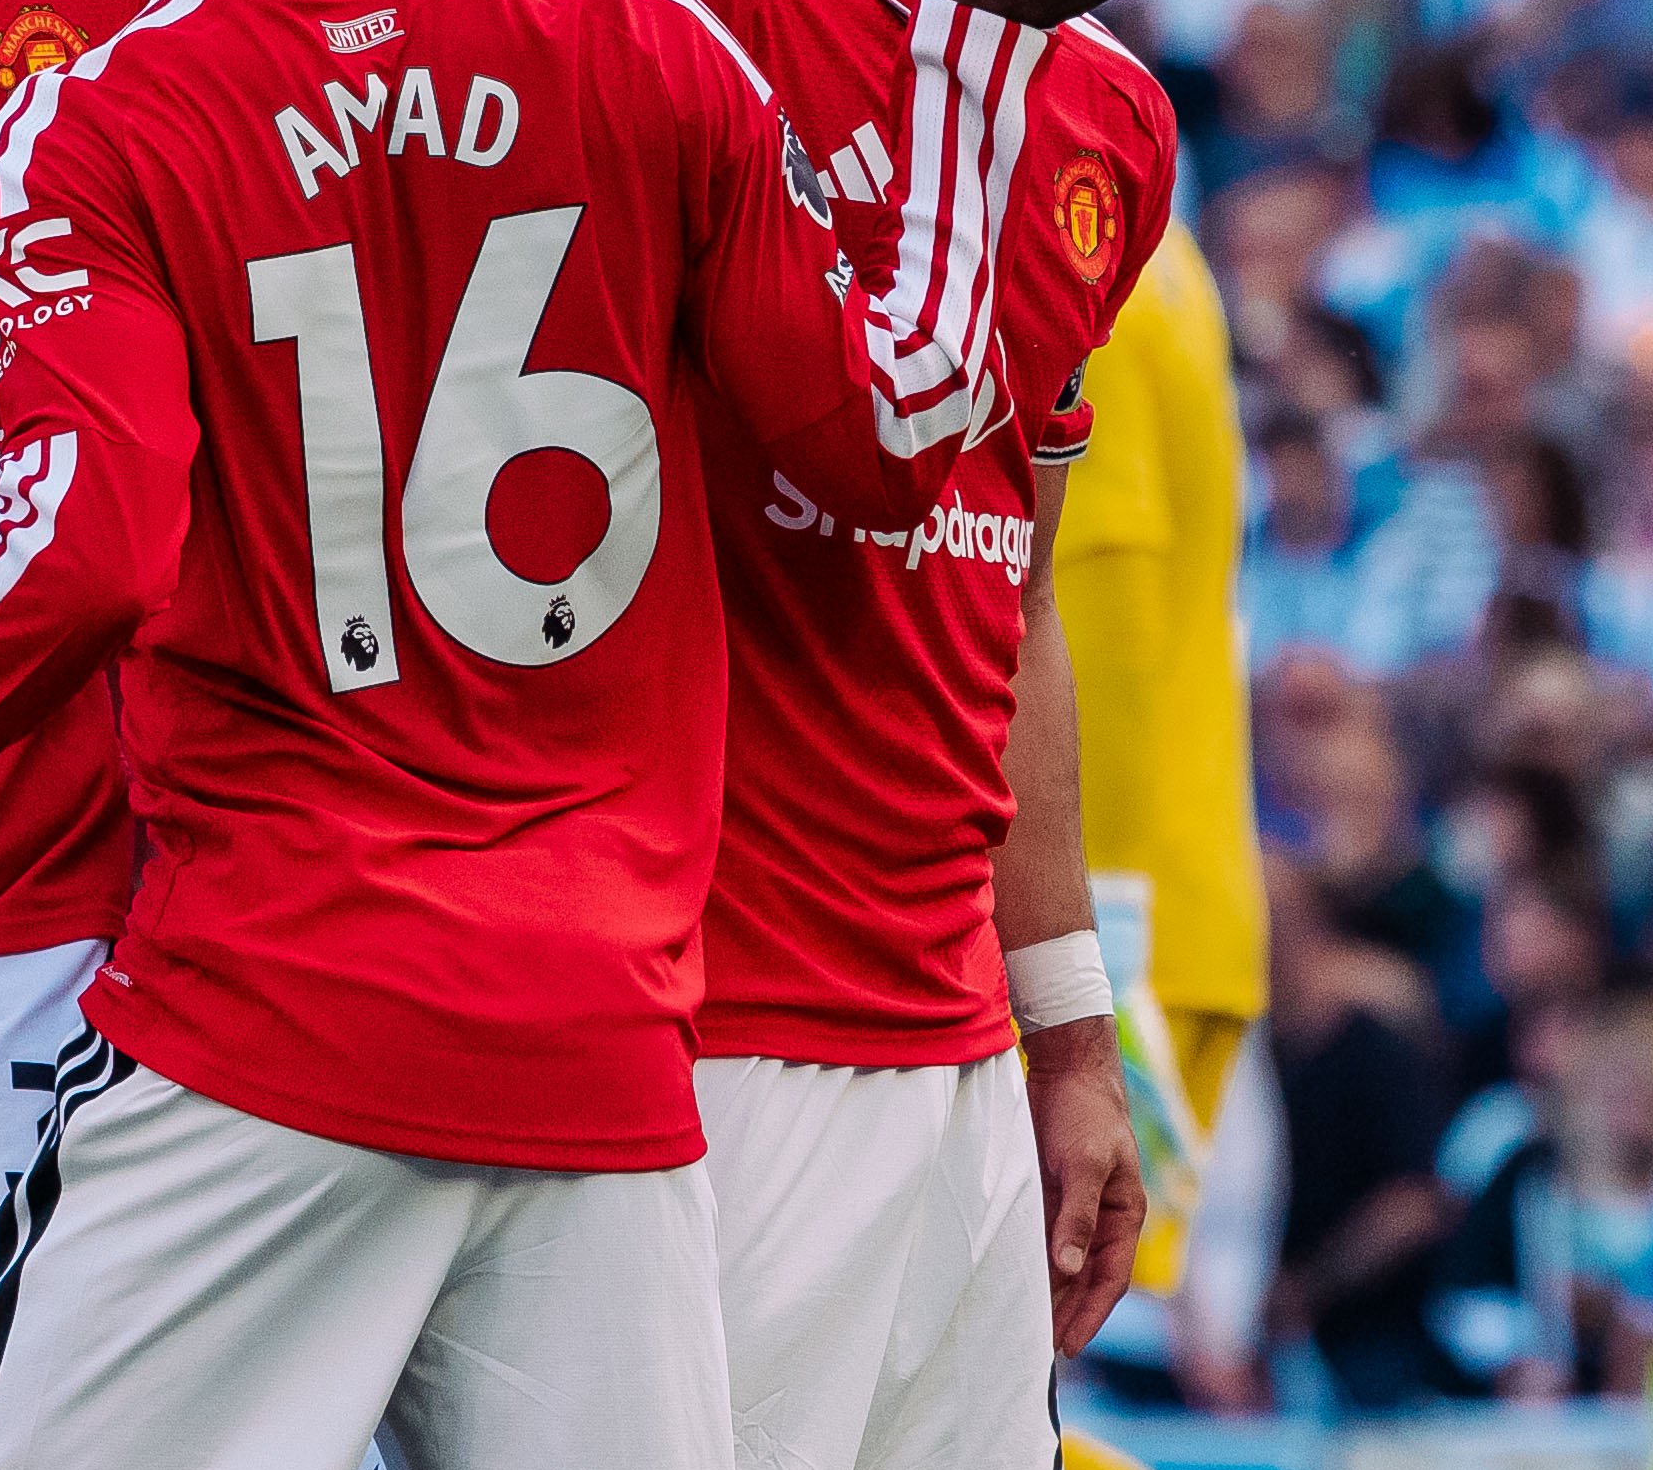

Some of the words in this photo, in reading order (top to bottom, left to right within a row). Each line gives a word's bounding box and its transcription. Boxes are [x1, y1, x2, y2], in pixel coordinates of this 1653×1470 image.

[1, 15, 84, 58] MANCHESTER
[324, 15, 395, 49] UNITED
[273, 65, 521, 202] AMAD
[245, 203, 662, 694] 16
